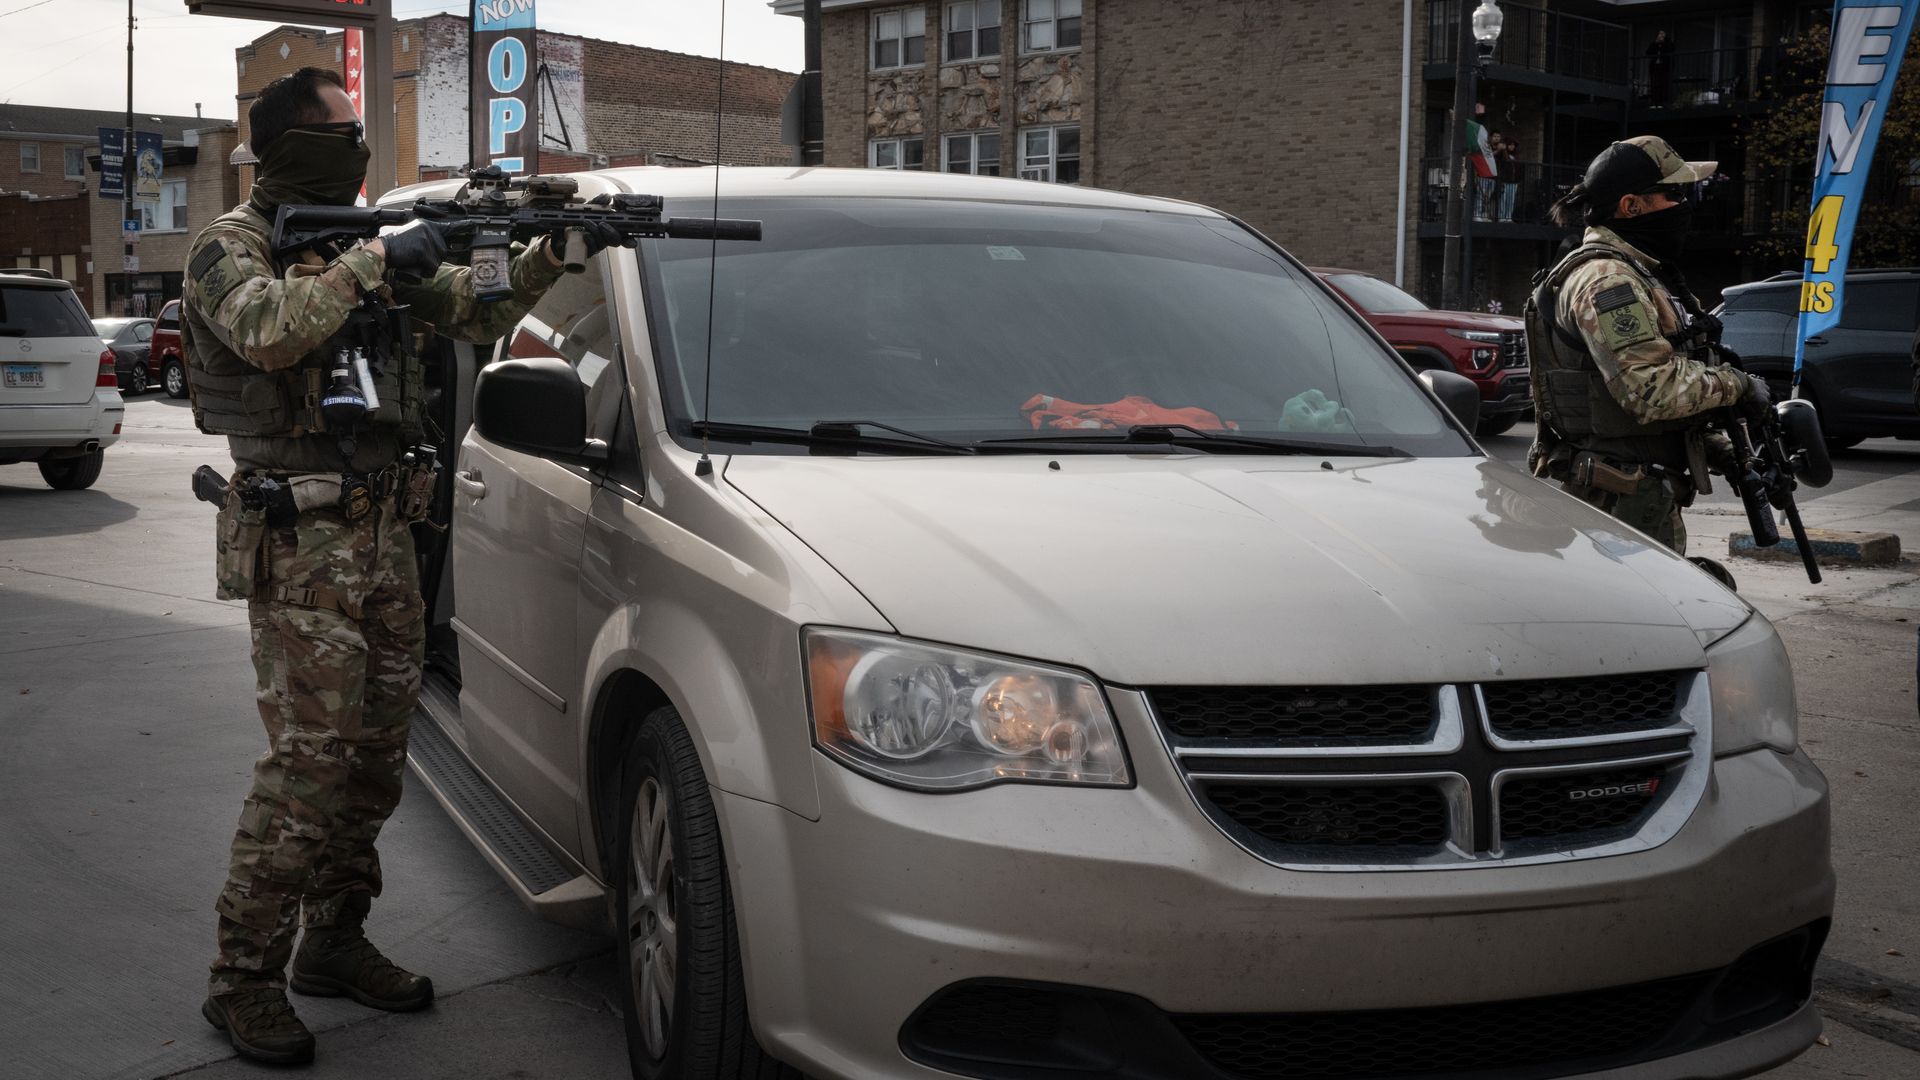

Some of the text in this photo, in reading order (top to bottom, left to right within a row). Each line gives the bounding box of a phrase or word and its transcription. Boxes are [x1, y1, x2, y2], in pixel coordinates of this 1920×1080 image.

[480, 0, 533, 24] NOW
[1805, 195, 1845, 273] 4
[1609, 306, 1632, 318] ICE
[328, 396, 354, 404] STINGER
[1569, 782, 1651, 800] DODGE
